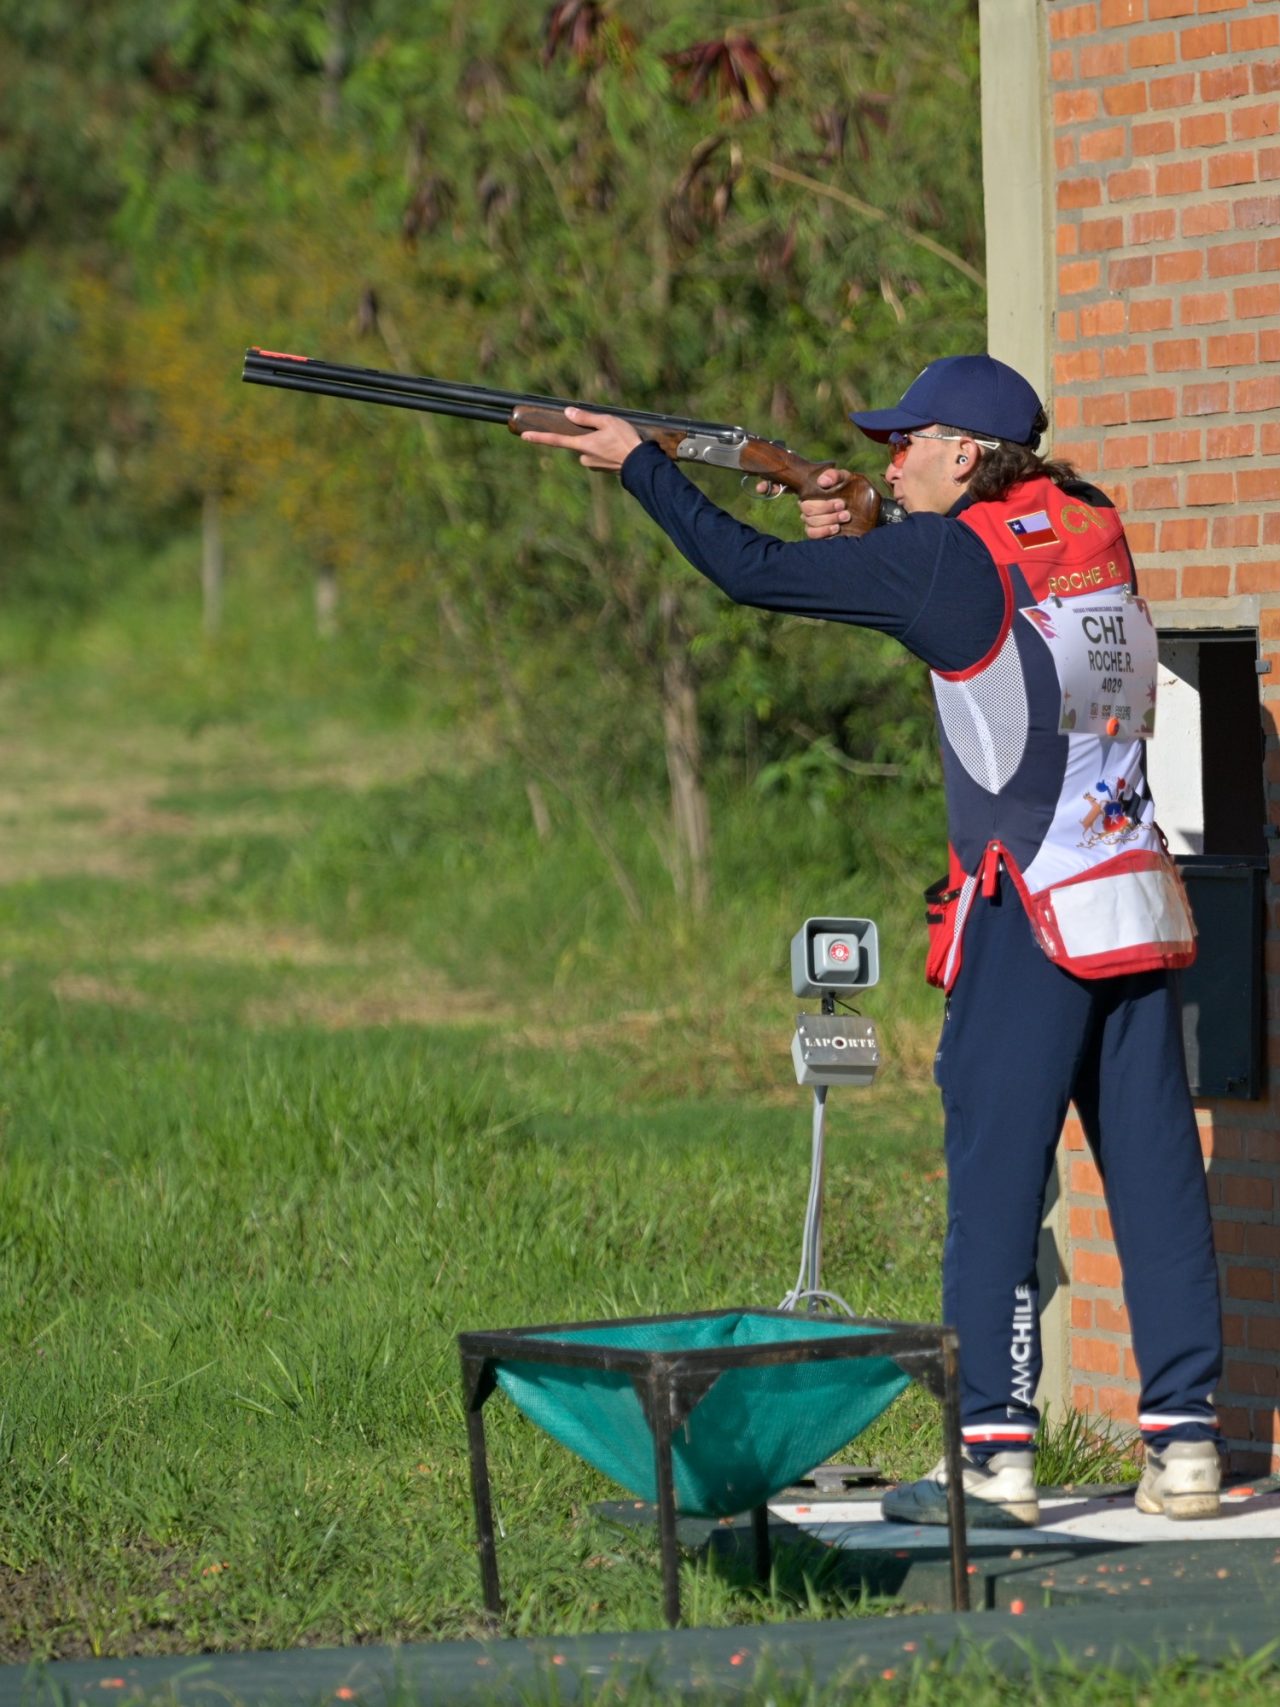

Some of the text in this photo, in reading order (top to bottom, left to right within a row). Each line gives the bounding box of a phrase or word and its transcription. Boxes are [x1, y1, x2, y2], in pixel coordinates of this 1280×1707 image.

[1048, 566, 1104, 594] ROCHE
[1081, 615, 1127, 645] CHI
[804, 1036, 876, 1050] LAPORTE
